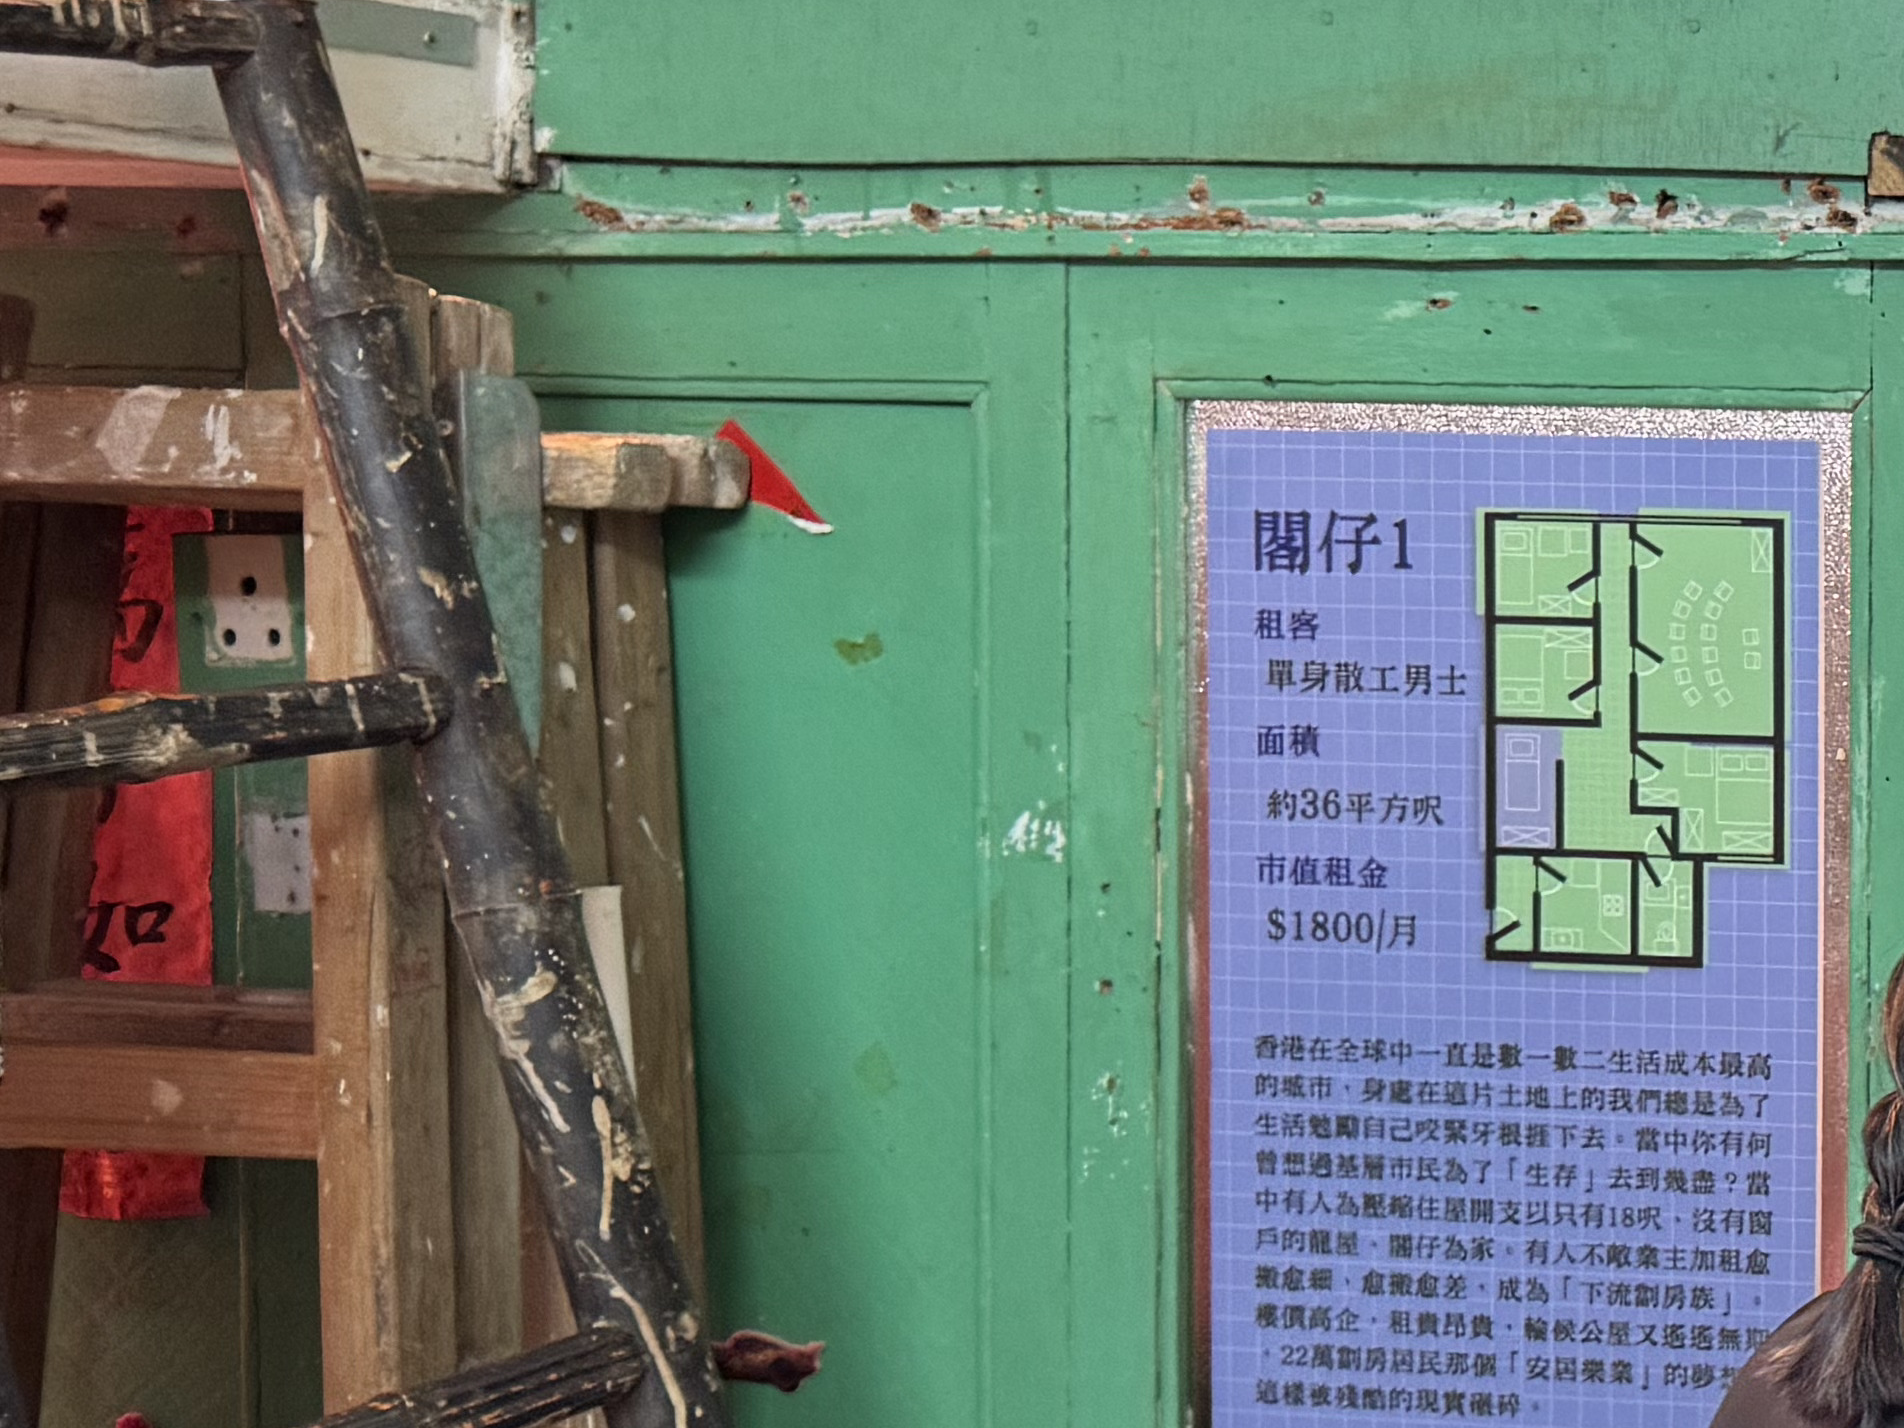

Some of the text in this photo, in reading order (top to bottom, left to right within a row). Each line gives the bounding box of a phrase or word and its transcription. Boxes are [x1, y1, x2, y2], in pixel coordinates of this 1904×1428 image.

[1254, 508, 1413, 575] 閣仔1
[1254, 608, 1320, 641] 租客
[1266, 658, 1468, 697] 單身散工男士
[1256, 723, 1320, 758] 面積
[1266, 787, 1445, 827] 約36平方呎
[1256, 853, 1390, 889] 市值租金
[1267, 906, 1418, 954] $1800/月
[1254, 1034, 1773, 1080] 香港在全球中一直是數一數二生活成本最高
